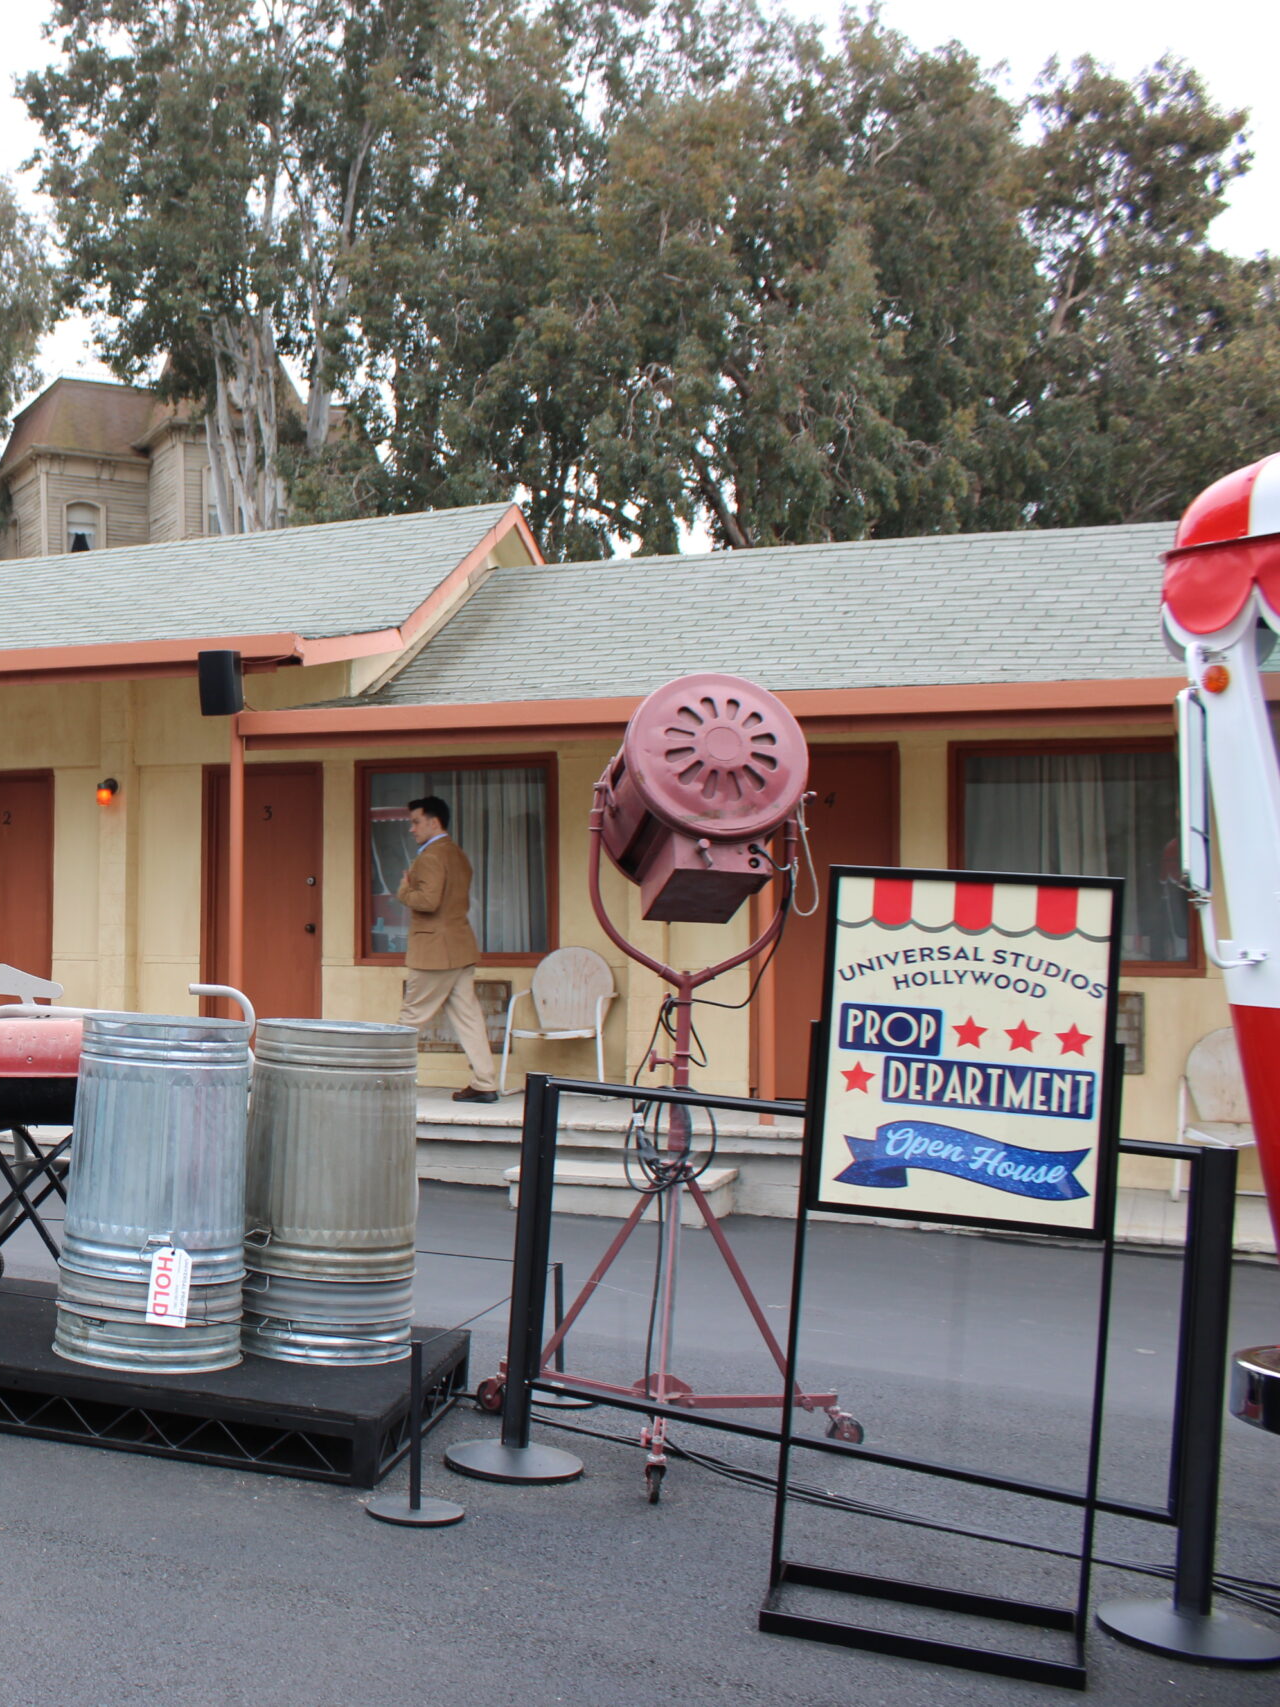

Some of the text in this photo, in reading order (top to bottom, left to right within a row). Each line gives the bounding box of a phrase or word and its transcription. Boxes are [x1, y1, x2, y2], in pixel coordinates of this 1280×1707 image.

[2, 810, 12, 825] 2
[263, 805, 273, 821] 3
[824, 792, 837, 808] 4
[838, 945, 1108, 1000] UNIVERSAL STUDIOS
[893, 969, 1047, 999] HOLLYWOOD
[846, 1008, 937, 1049] PROP
[887, 1060, 1093, 1114] DEPARTMENT
[885, 1127, 1068, 1184] Open House
[152, 1256, 174, 1317] HOLD
